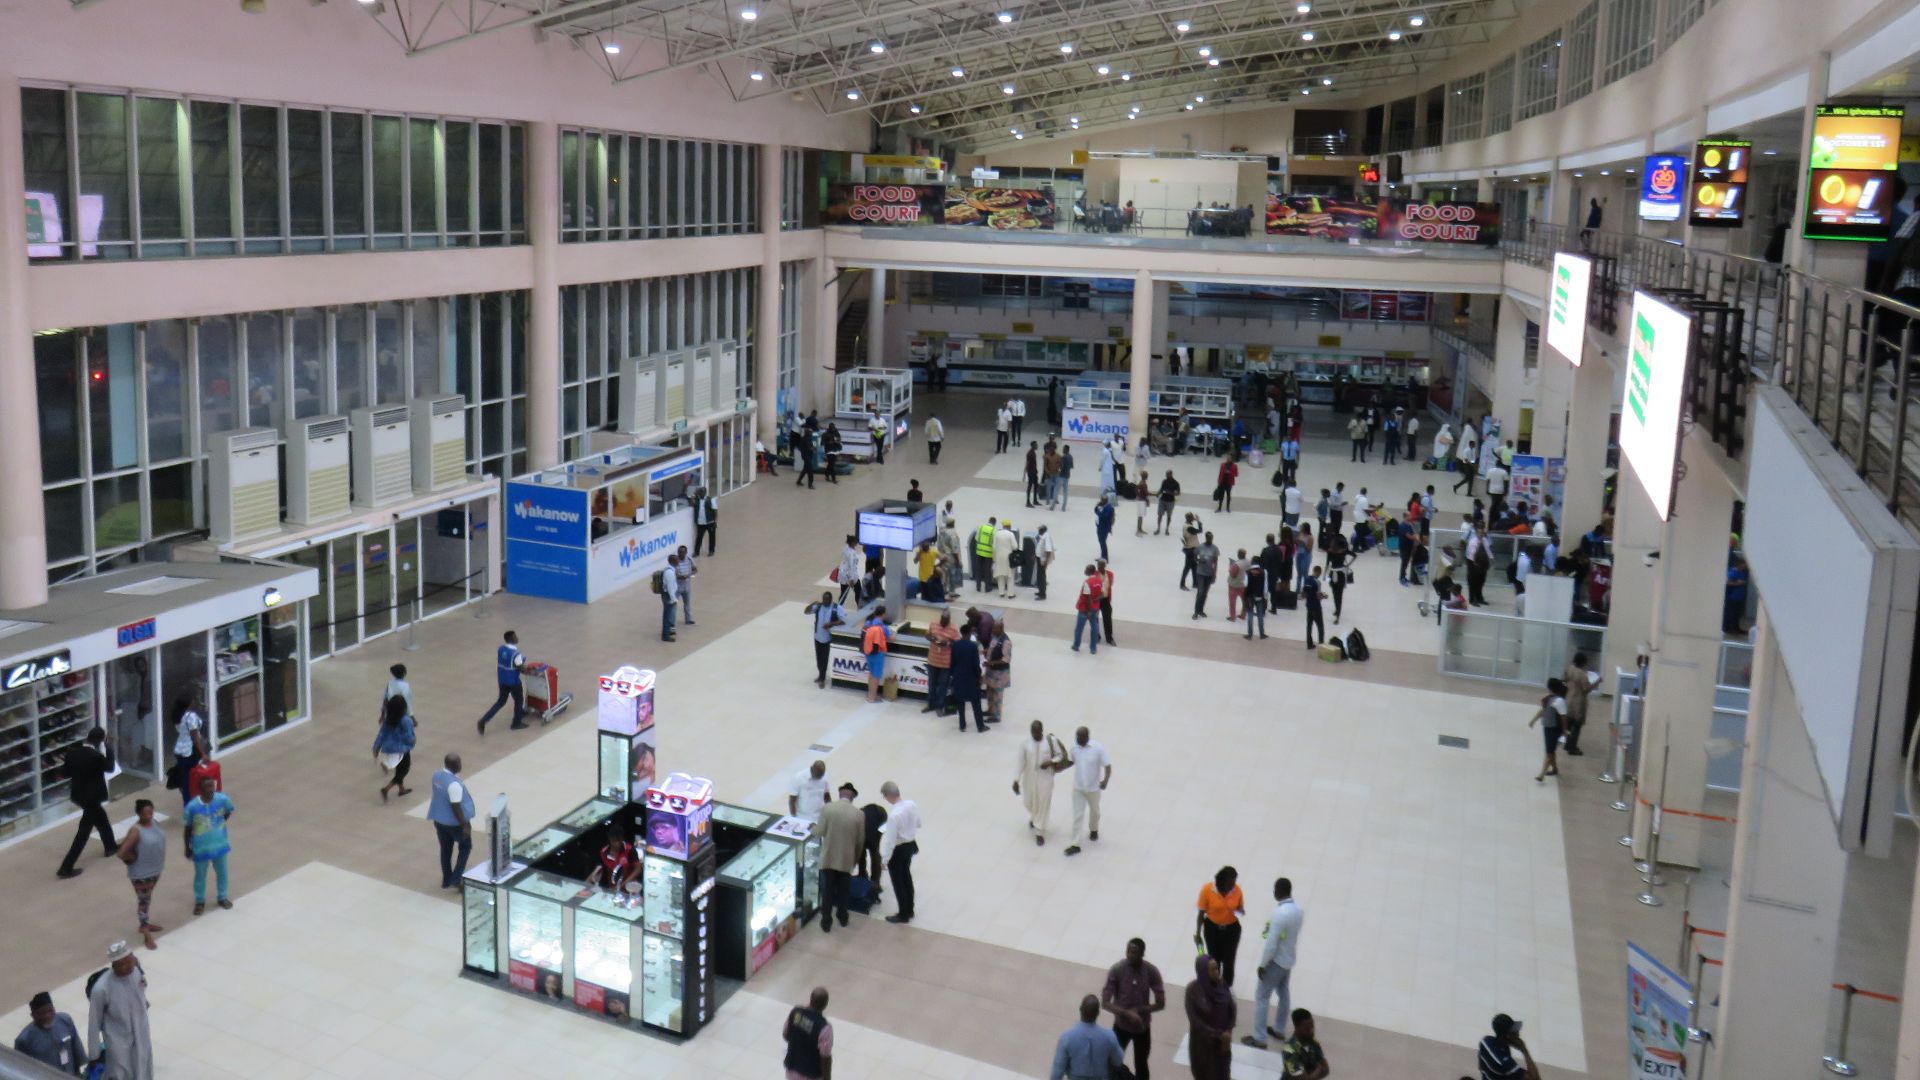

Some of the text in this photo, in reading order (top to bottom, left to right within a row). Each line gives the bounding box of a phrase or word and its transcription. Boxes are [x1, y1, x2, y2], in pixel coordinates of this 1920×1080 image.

[853, 186, 916, 203] FOOD
[848, 204, 921, 222] COURT
[1406, 204, 1475, 222] FOOD
[1399, 223, 1480, 241] COURT
[1068, 414, 1129, 436] Wakano
[514, 500, 580, 524] Wakanow
[619, 530, 678, 568] Wakanow
[6, 656, 71, 689] Clarks
[1644, 1060, 1677, 1078] EXIT
